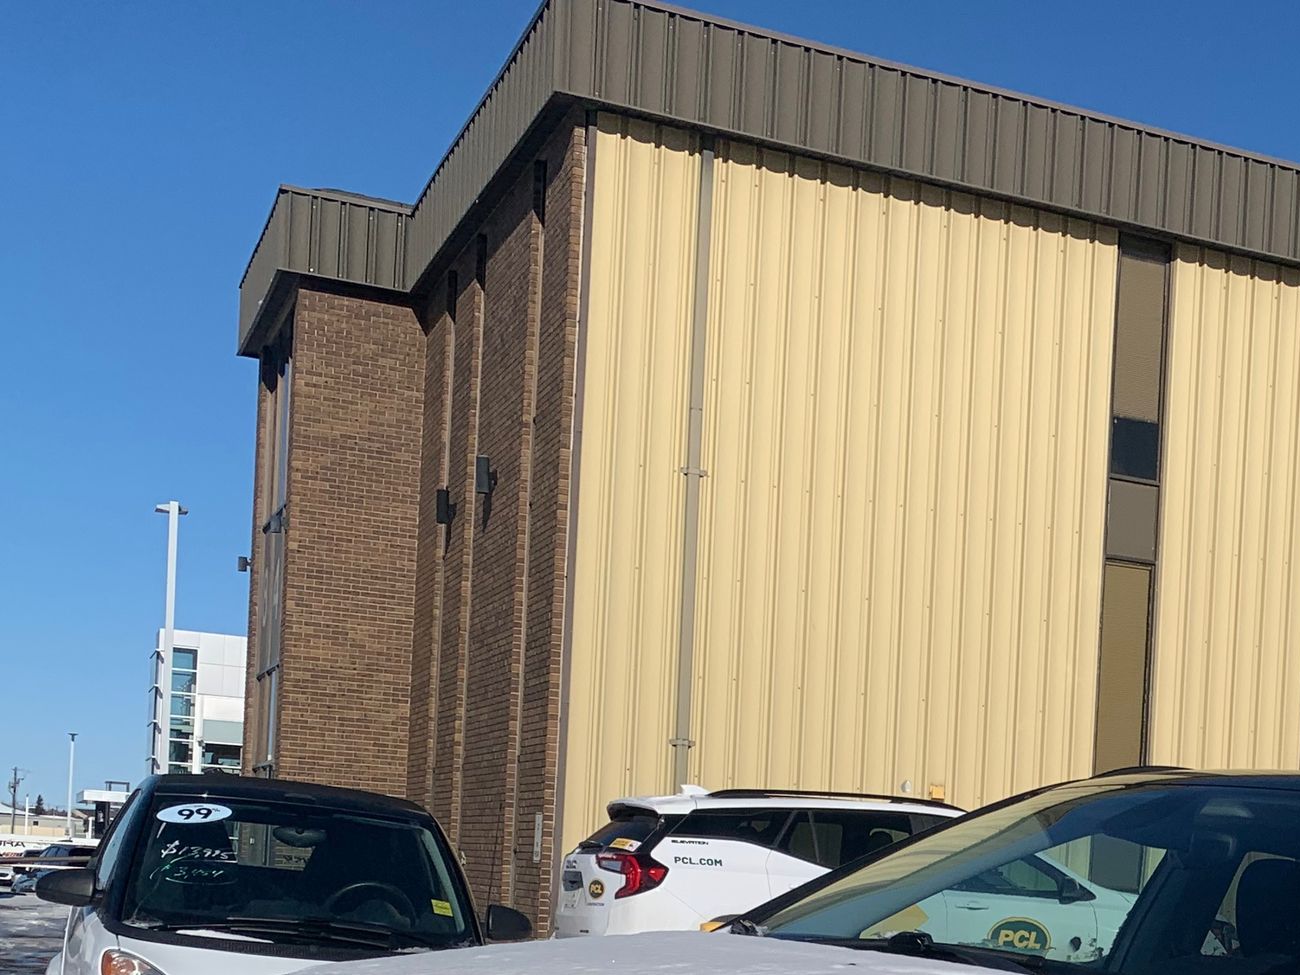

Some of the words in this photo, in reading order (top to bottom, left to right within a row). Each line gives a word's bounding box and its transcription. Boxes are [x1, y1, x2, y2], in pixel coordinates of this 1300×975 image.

[177, 808, 212, 820] 99
[674, 856, 723, 867] PCL.COM
[590, 884, 603, 894] PCL
[998, 930, 1041, 949] PCL
